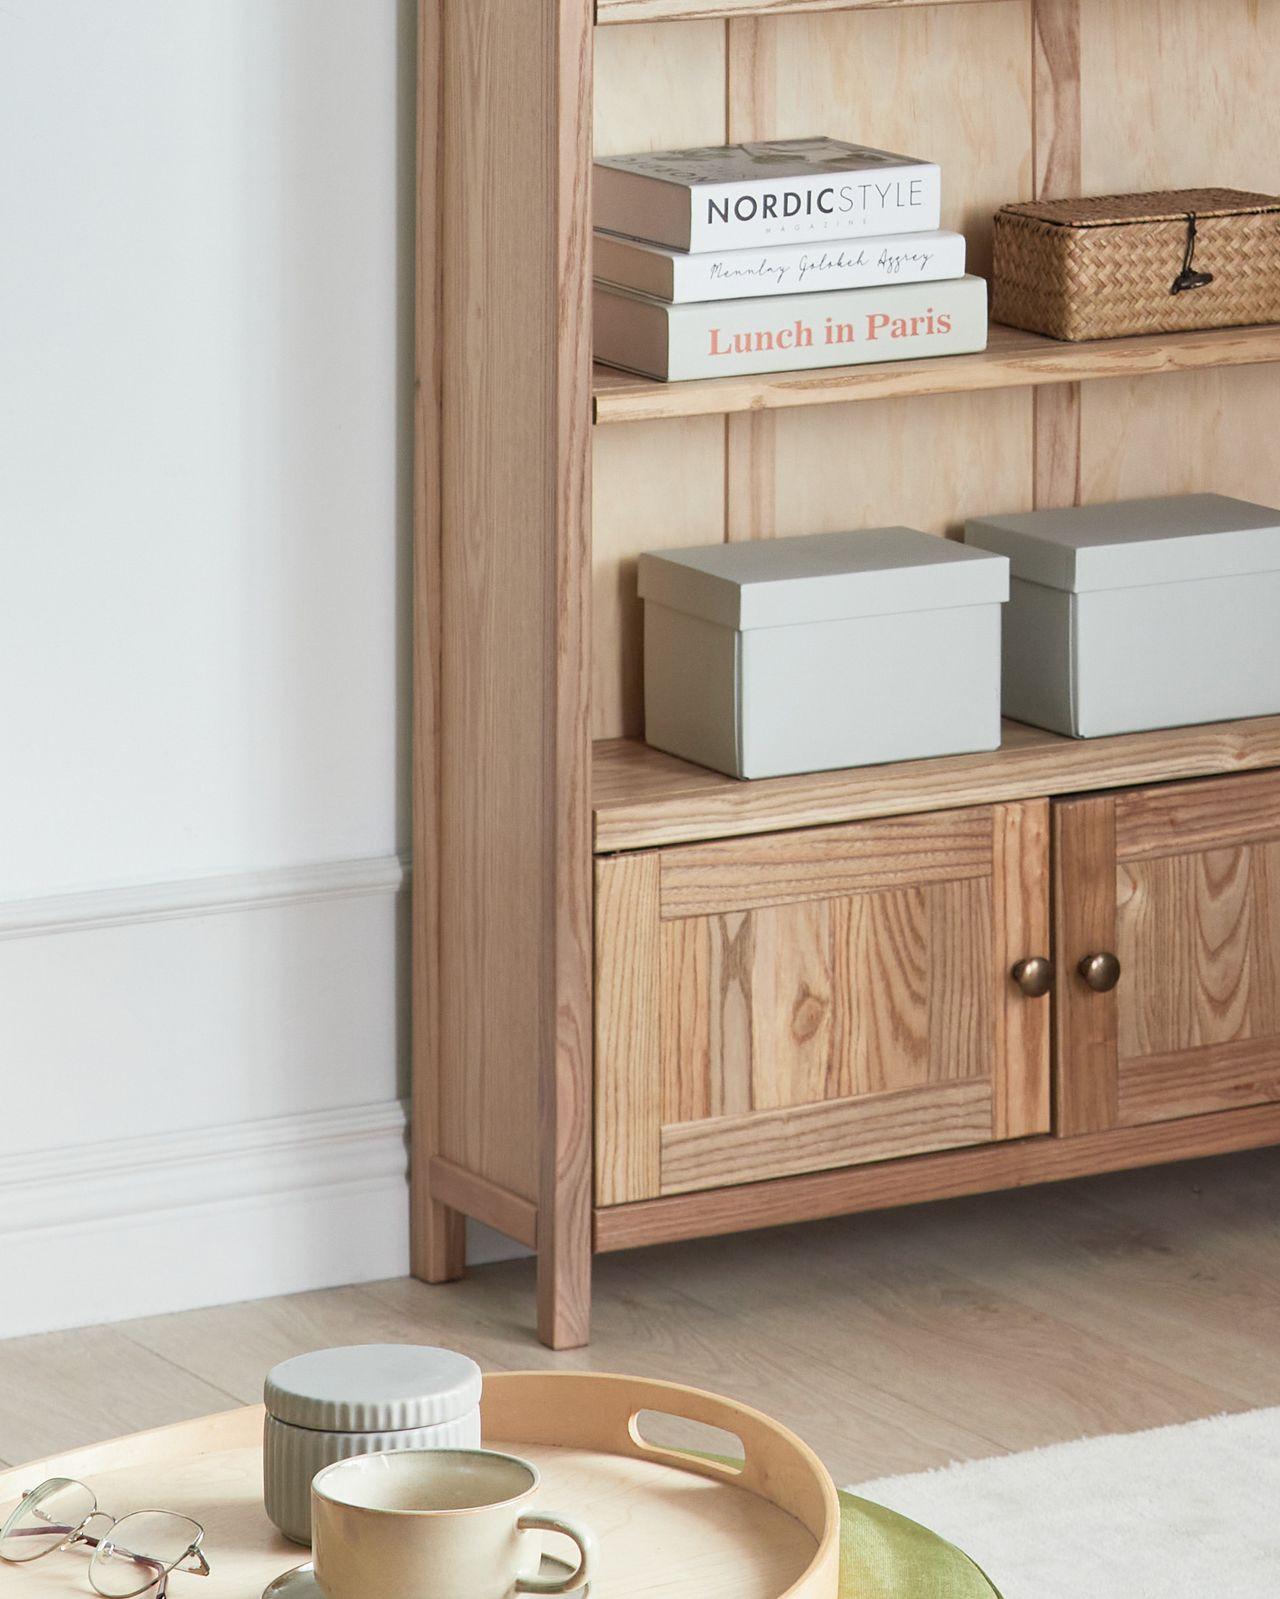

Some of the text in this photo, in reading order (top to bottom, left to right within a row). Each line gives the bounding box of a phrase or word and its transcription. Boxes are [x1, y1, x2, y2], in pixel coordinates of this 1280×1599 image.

[708, 307, 952, 356] Lunch in Paris
